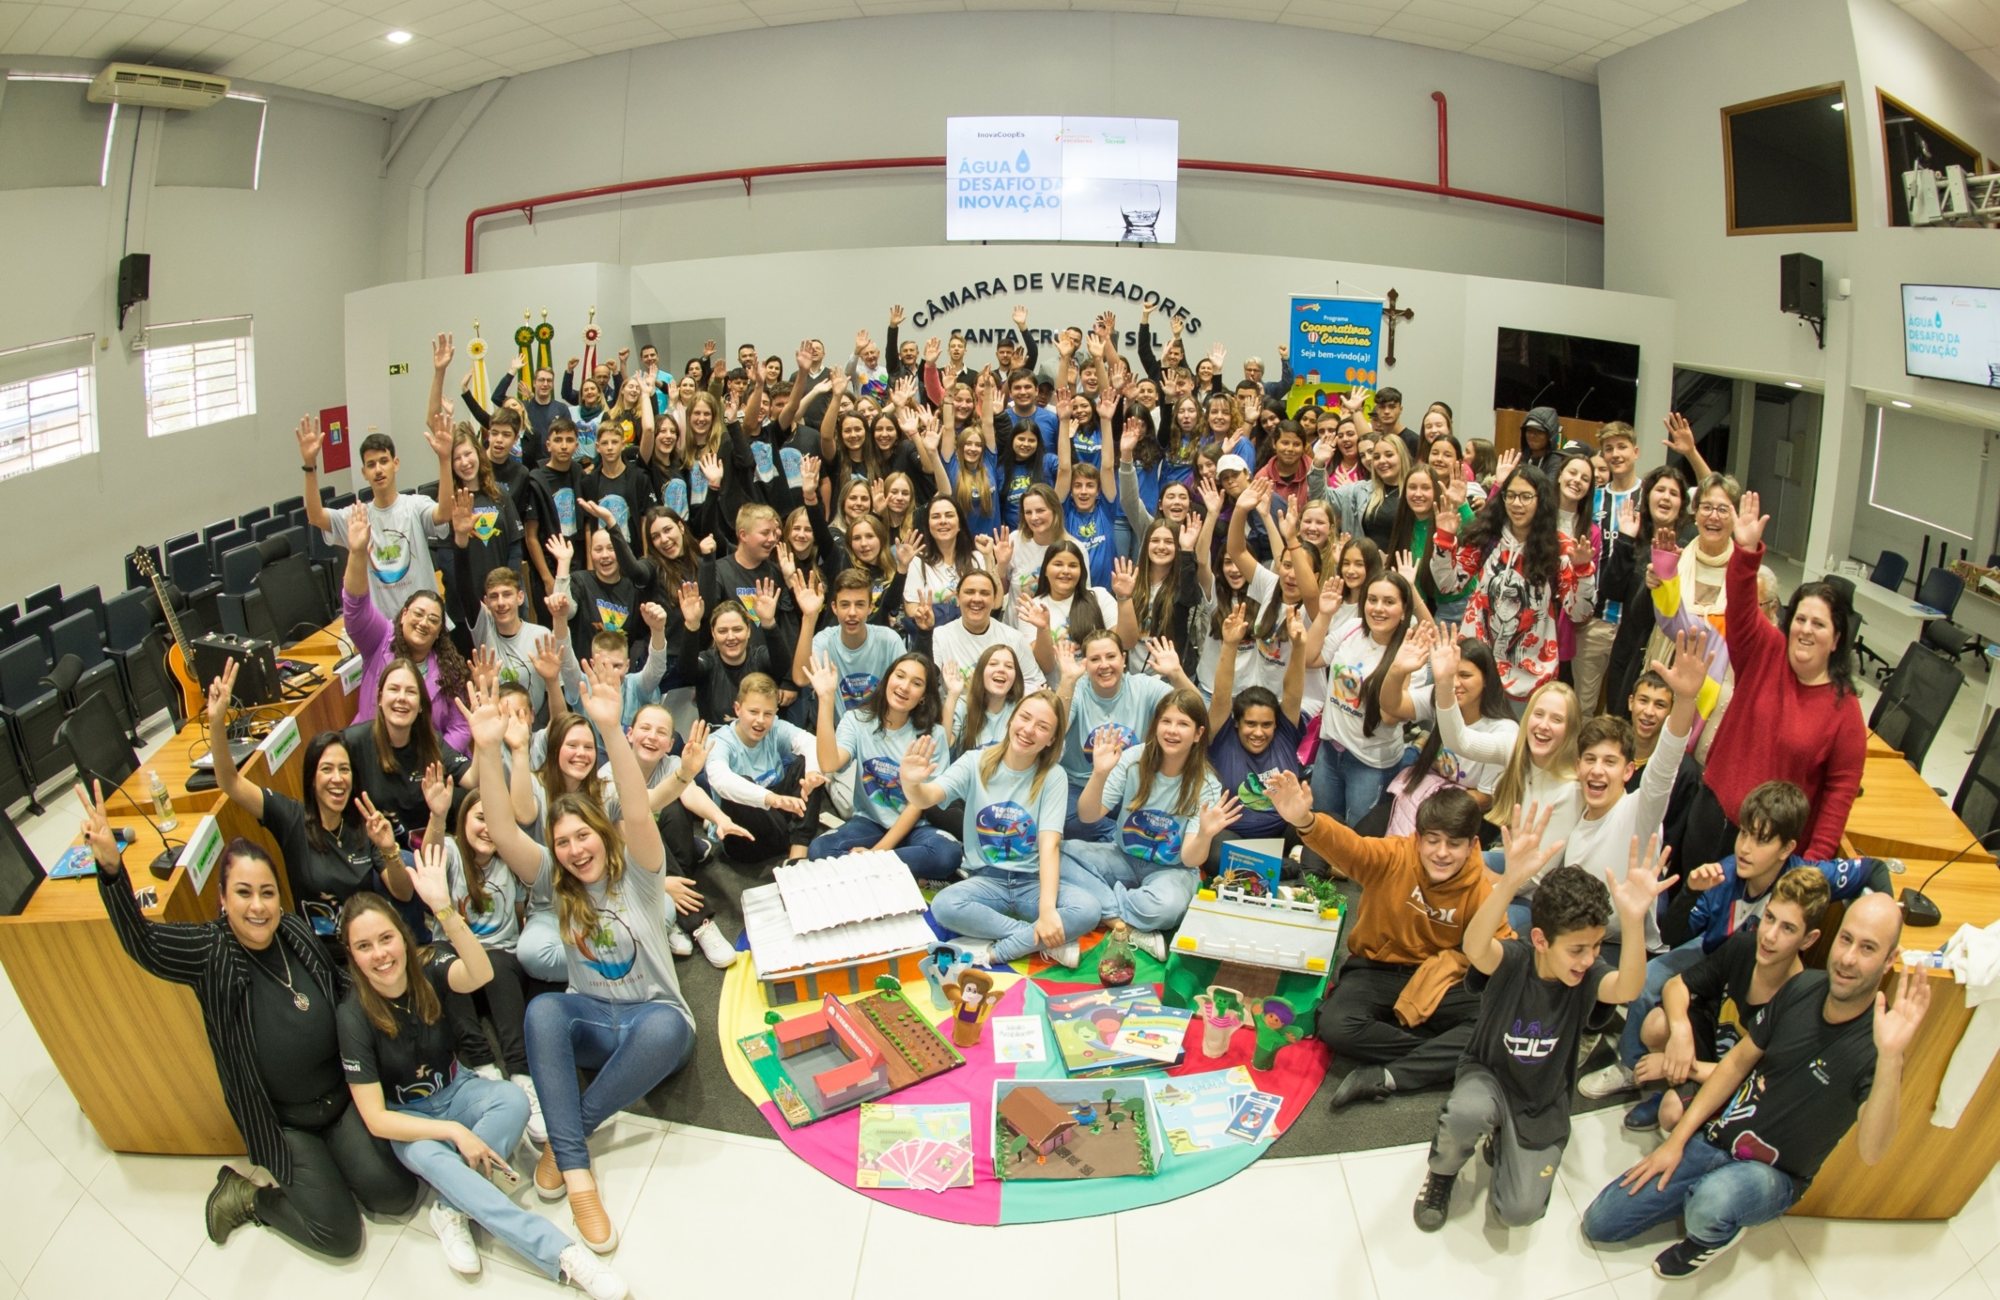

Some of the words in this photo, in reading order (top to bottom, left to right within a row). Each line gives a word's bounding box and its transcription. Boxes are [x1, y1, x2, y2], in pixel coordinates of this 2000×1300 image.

[959, 157, 1012, 174] ÁGUA
[958, 177, 1036, 192] DESAFIO
[958, 192, 1060, 214] INOVAÇÃO
[912, 277, 1008, 329] CÂMARA
[1013, 272, 1044, 292] DE
[1050, 272, 1202, 336] VEREADORES
[1300, 321, 1371, 335] Cooperativas
[1125, 331, 1163, 347] SL
[1320, 333, 1372, 347] Escolares
[1909, 330, 1945, 342] DESAFIO
[1300, 348, 1316, 360] Seja
[1318, 350, 1370, 363] bem-vindo(a)!
[1909, 344, 1958, 358] INOVAÇÃO
